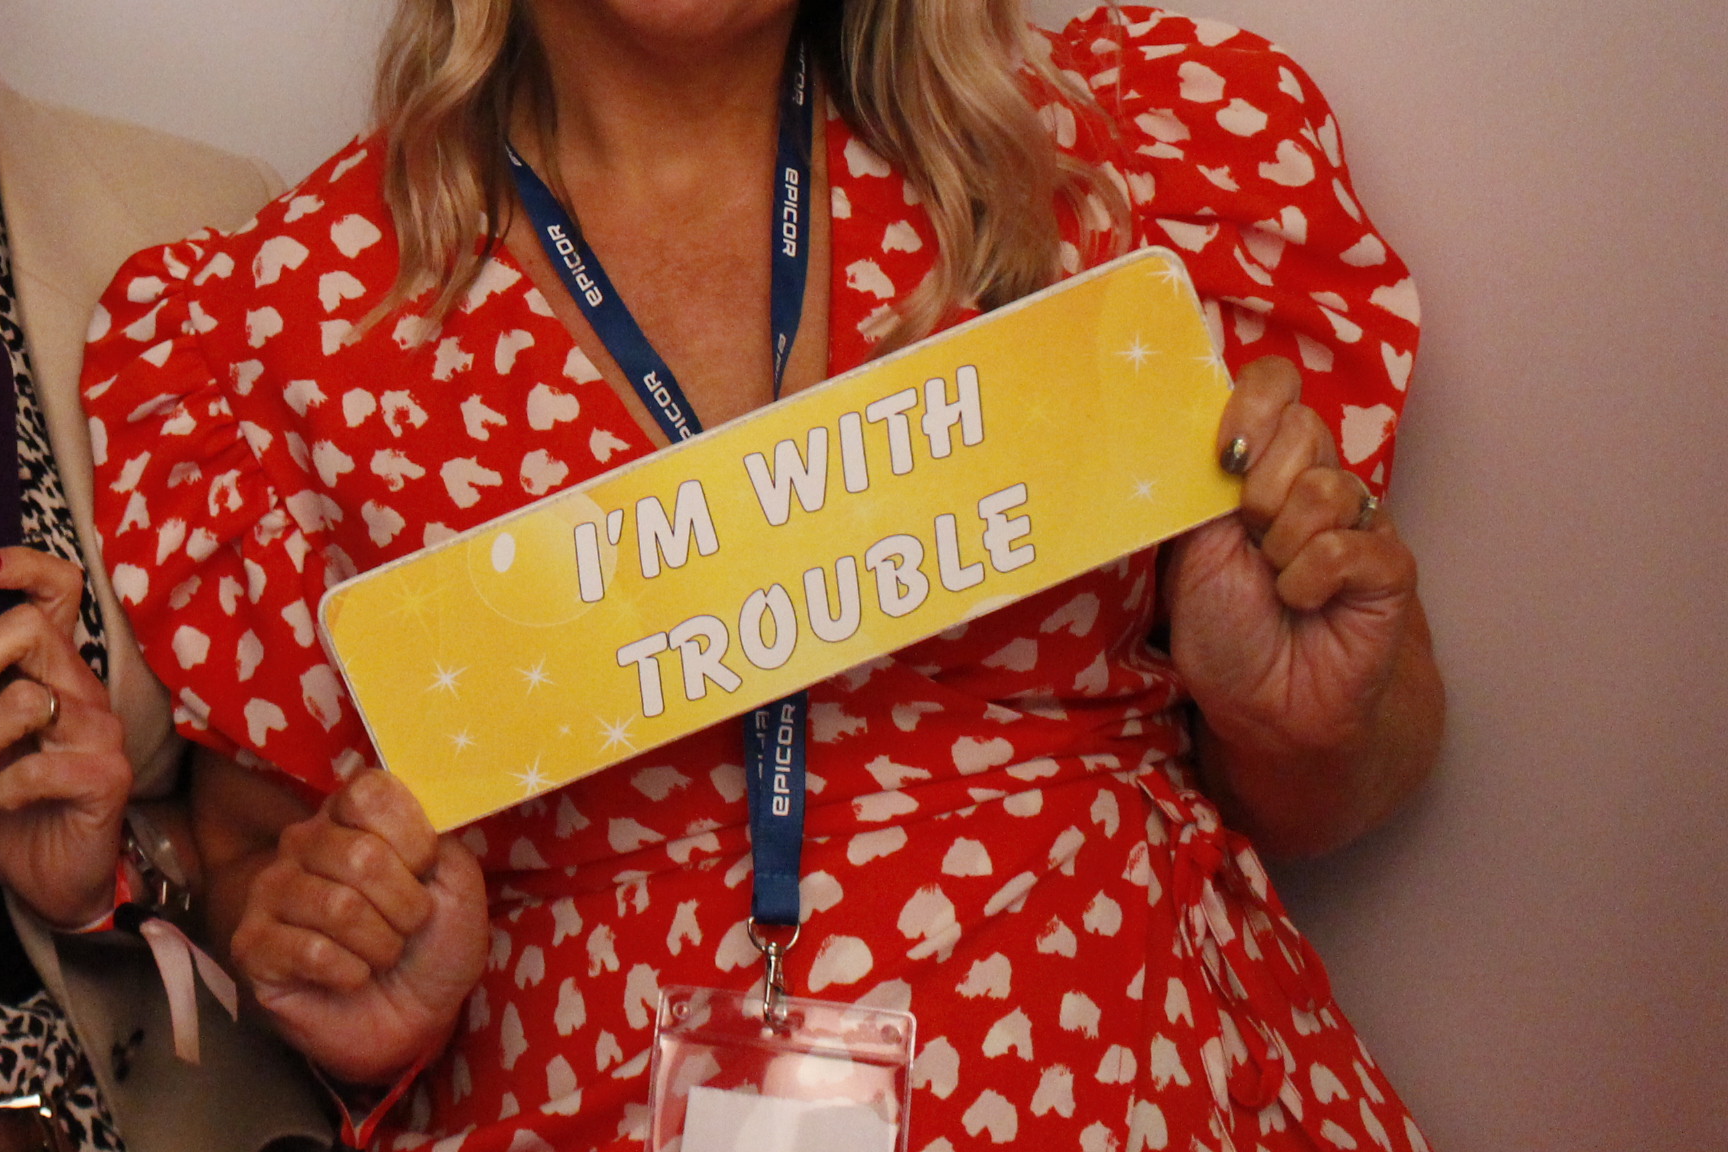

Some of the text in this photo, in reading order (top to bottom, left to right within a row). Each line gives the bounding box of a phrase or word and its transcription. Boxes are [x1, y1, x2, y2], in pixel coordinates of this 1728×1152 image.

[573, 364, 985, 604] I'M WITH
[643, 370, 694, 441] PICOR
[616, 481, 1036, 719] TROUBLE
